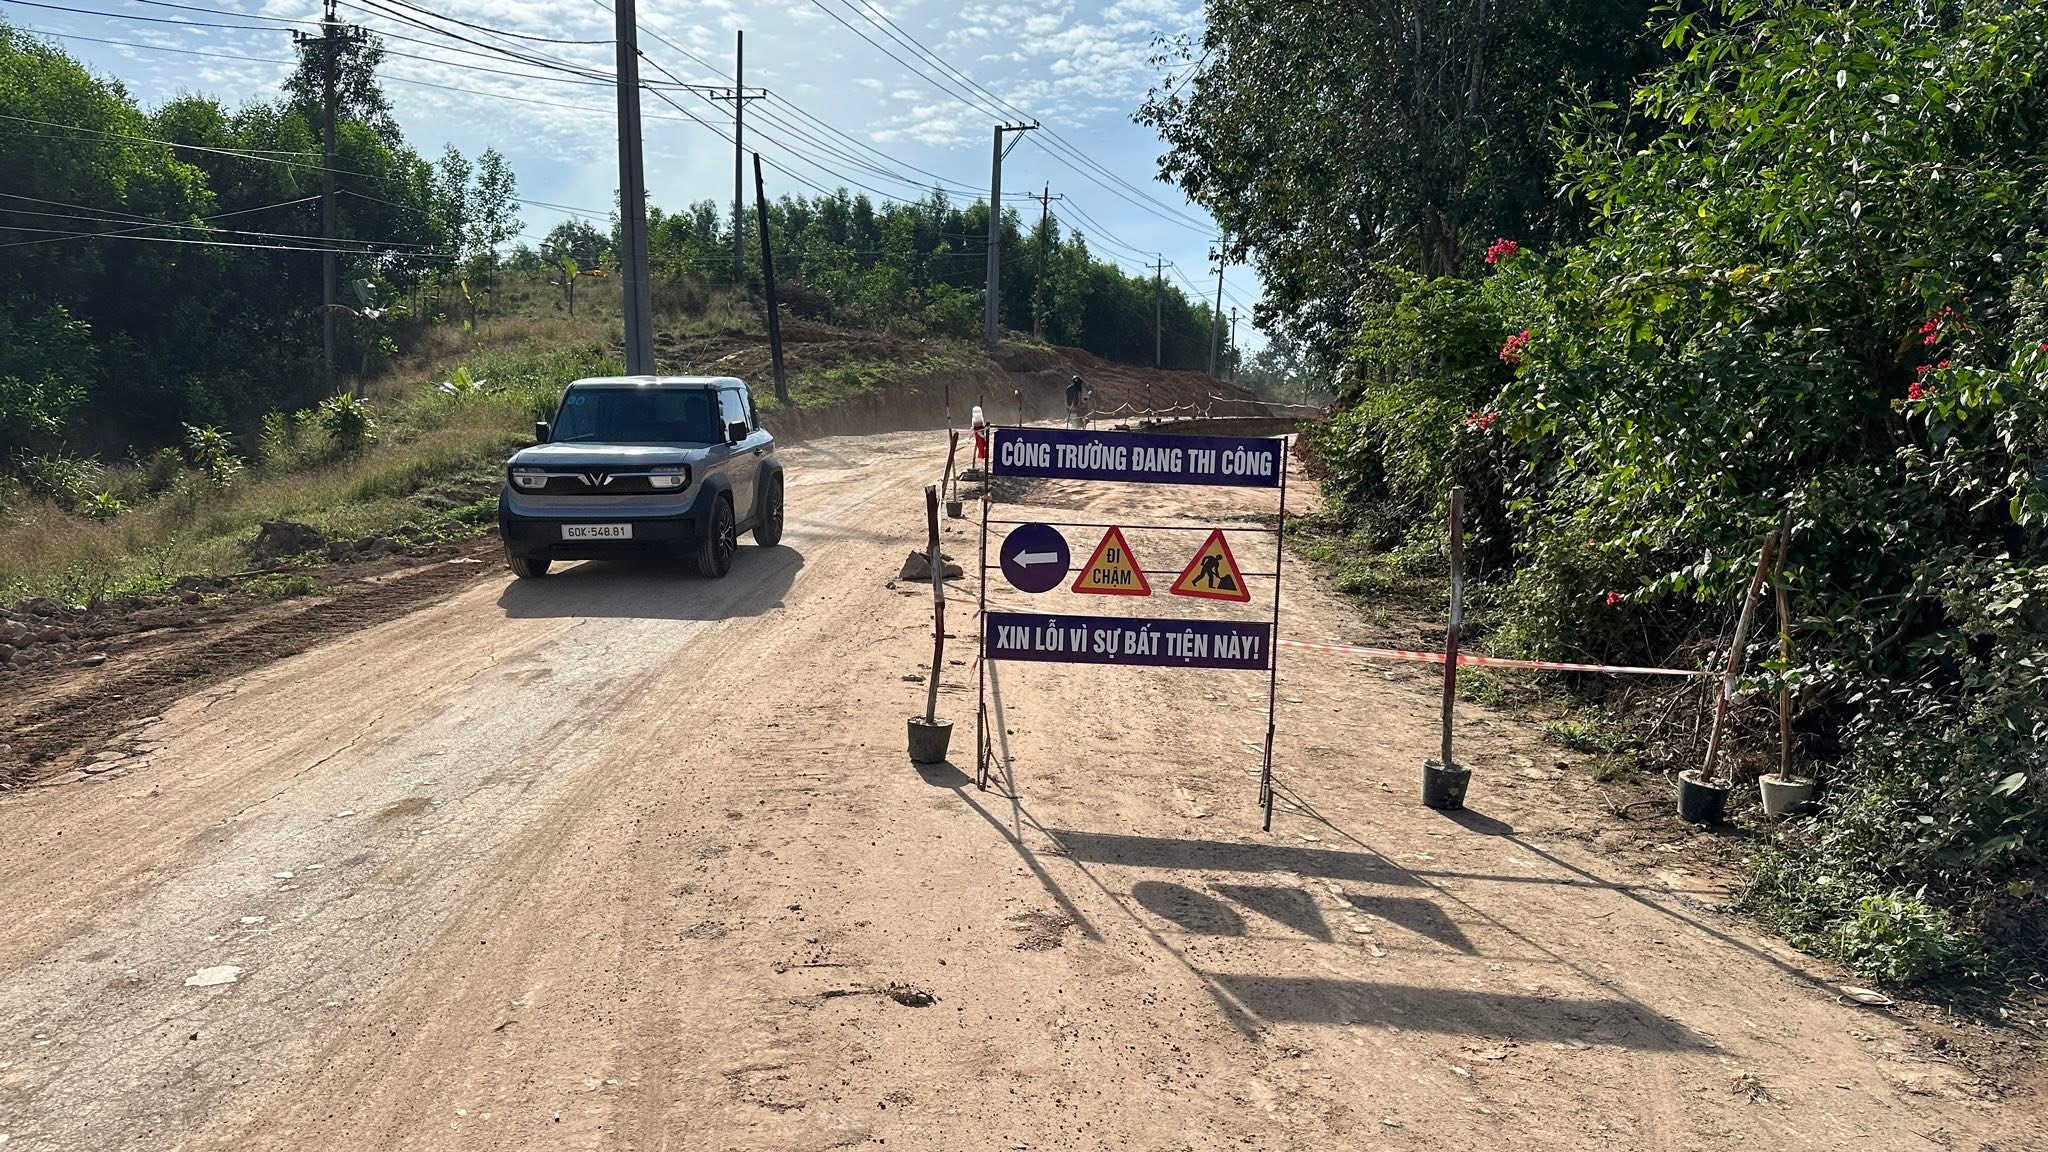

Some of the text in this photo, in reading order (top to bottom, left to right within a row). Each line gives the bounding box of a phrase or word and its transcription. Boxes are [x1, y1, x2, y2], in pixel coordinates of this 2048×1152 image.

[1001, 437, 1272, 476] CÔNG TRƯỜNG ĐANG THI CÔNG
[1106, 548, 1121, 564] ĐI
[1092, 566, 1132, 588] CHẬM
[997, 619, 1260, 662] XIN LỖI VÌ SỰ BẤT TIỆN NÀY!
